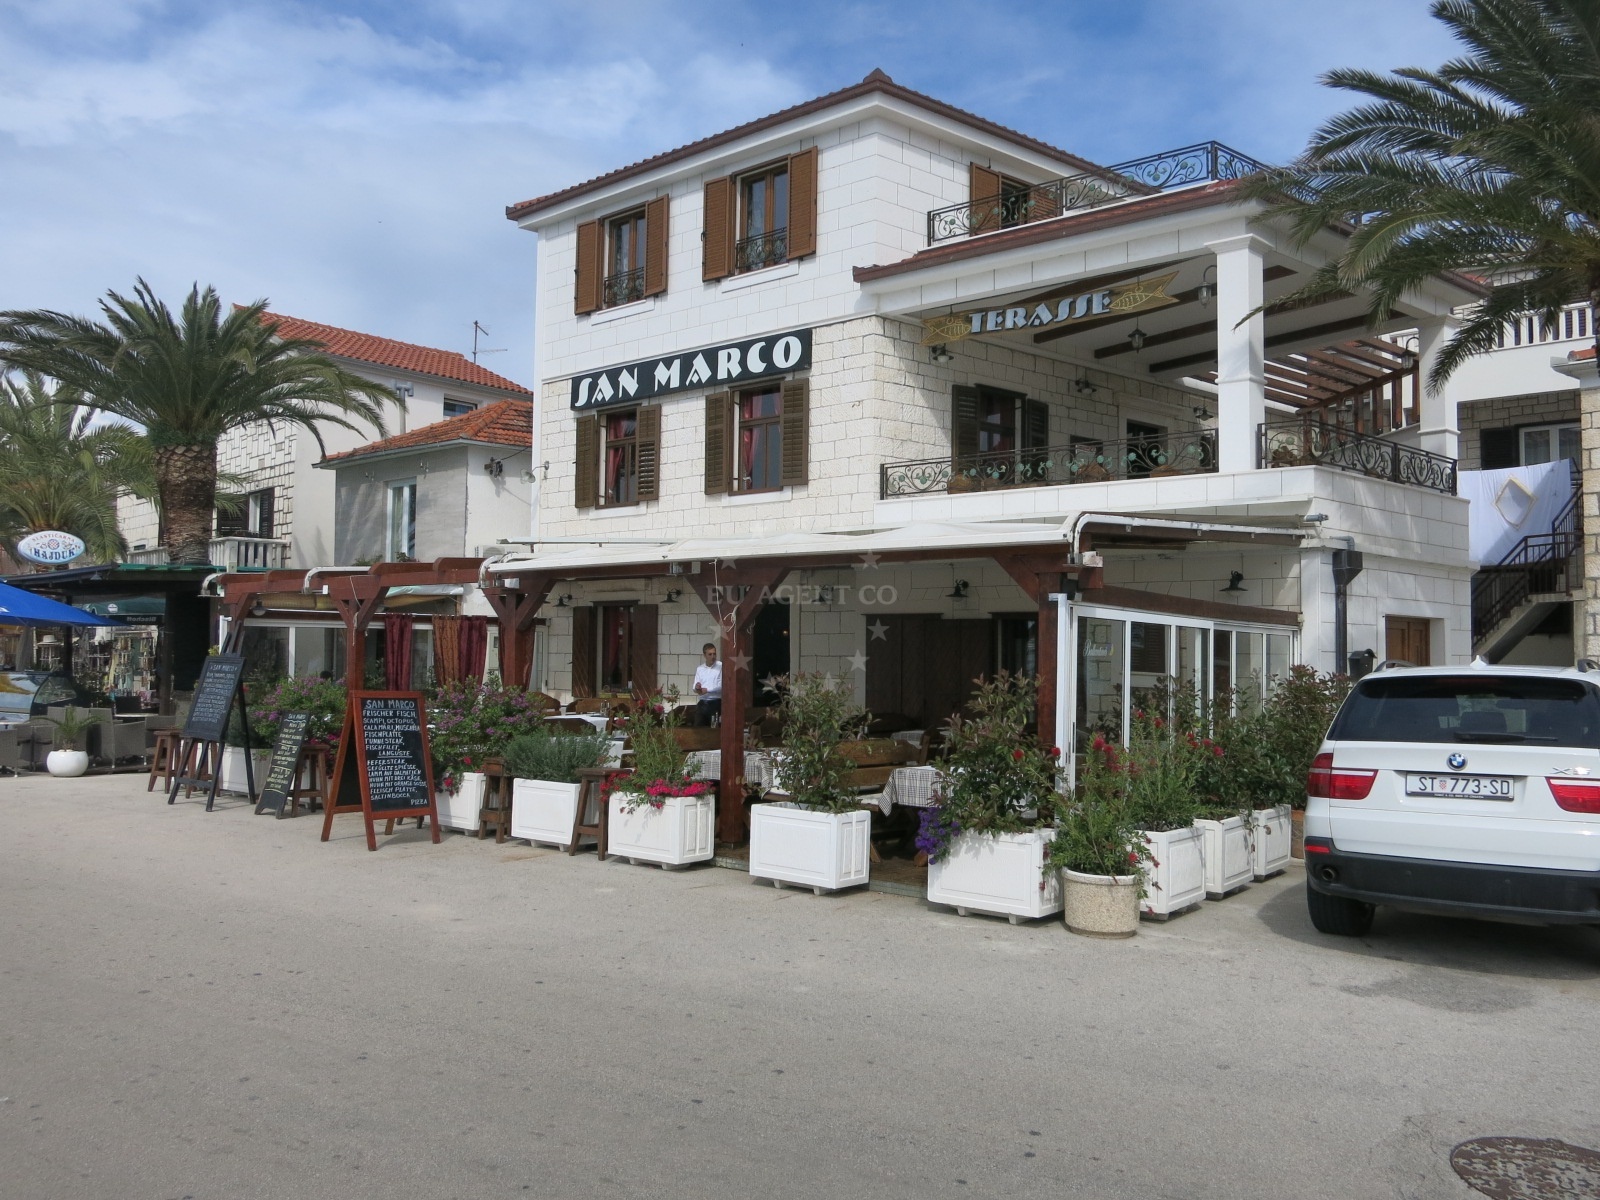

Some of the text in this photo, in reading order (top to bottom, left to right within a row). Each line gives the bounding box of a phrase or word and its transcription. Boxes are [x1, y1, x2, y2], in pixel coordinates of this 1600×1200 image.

[969, 290, 1112, 334] TERASSE
[575, 336, 802, 407] SAN MARCO
[34, 548, 75, 560] HAJDUK
[365, 700, 415, 709] SAN MARCO
[1419, 777, 1510, 795] ST 773-SD
